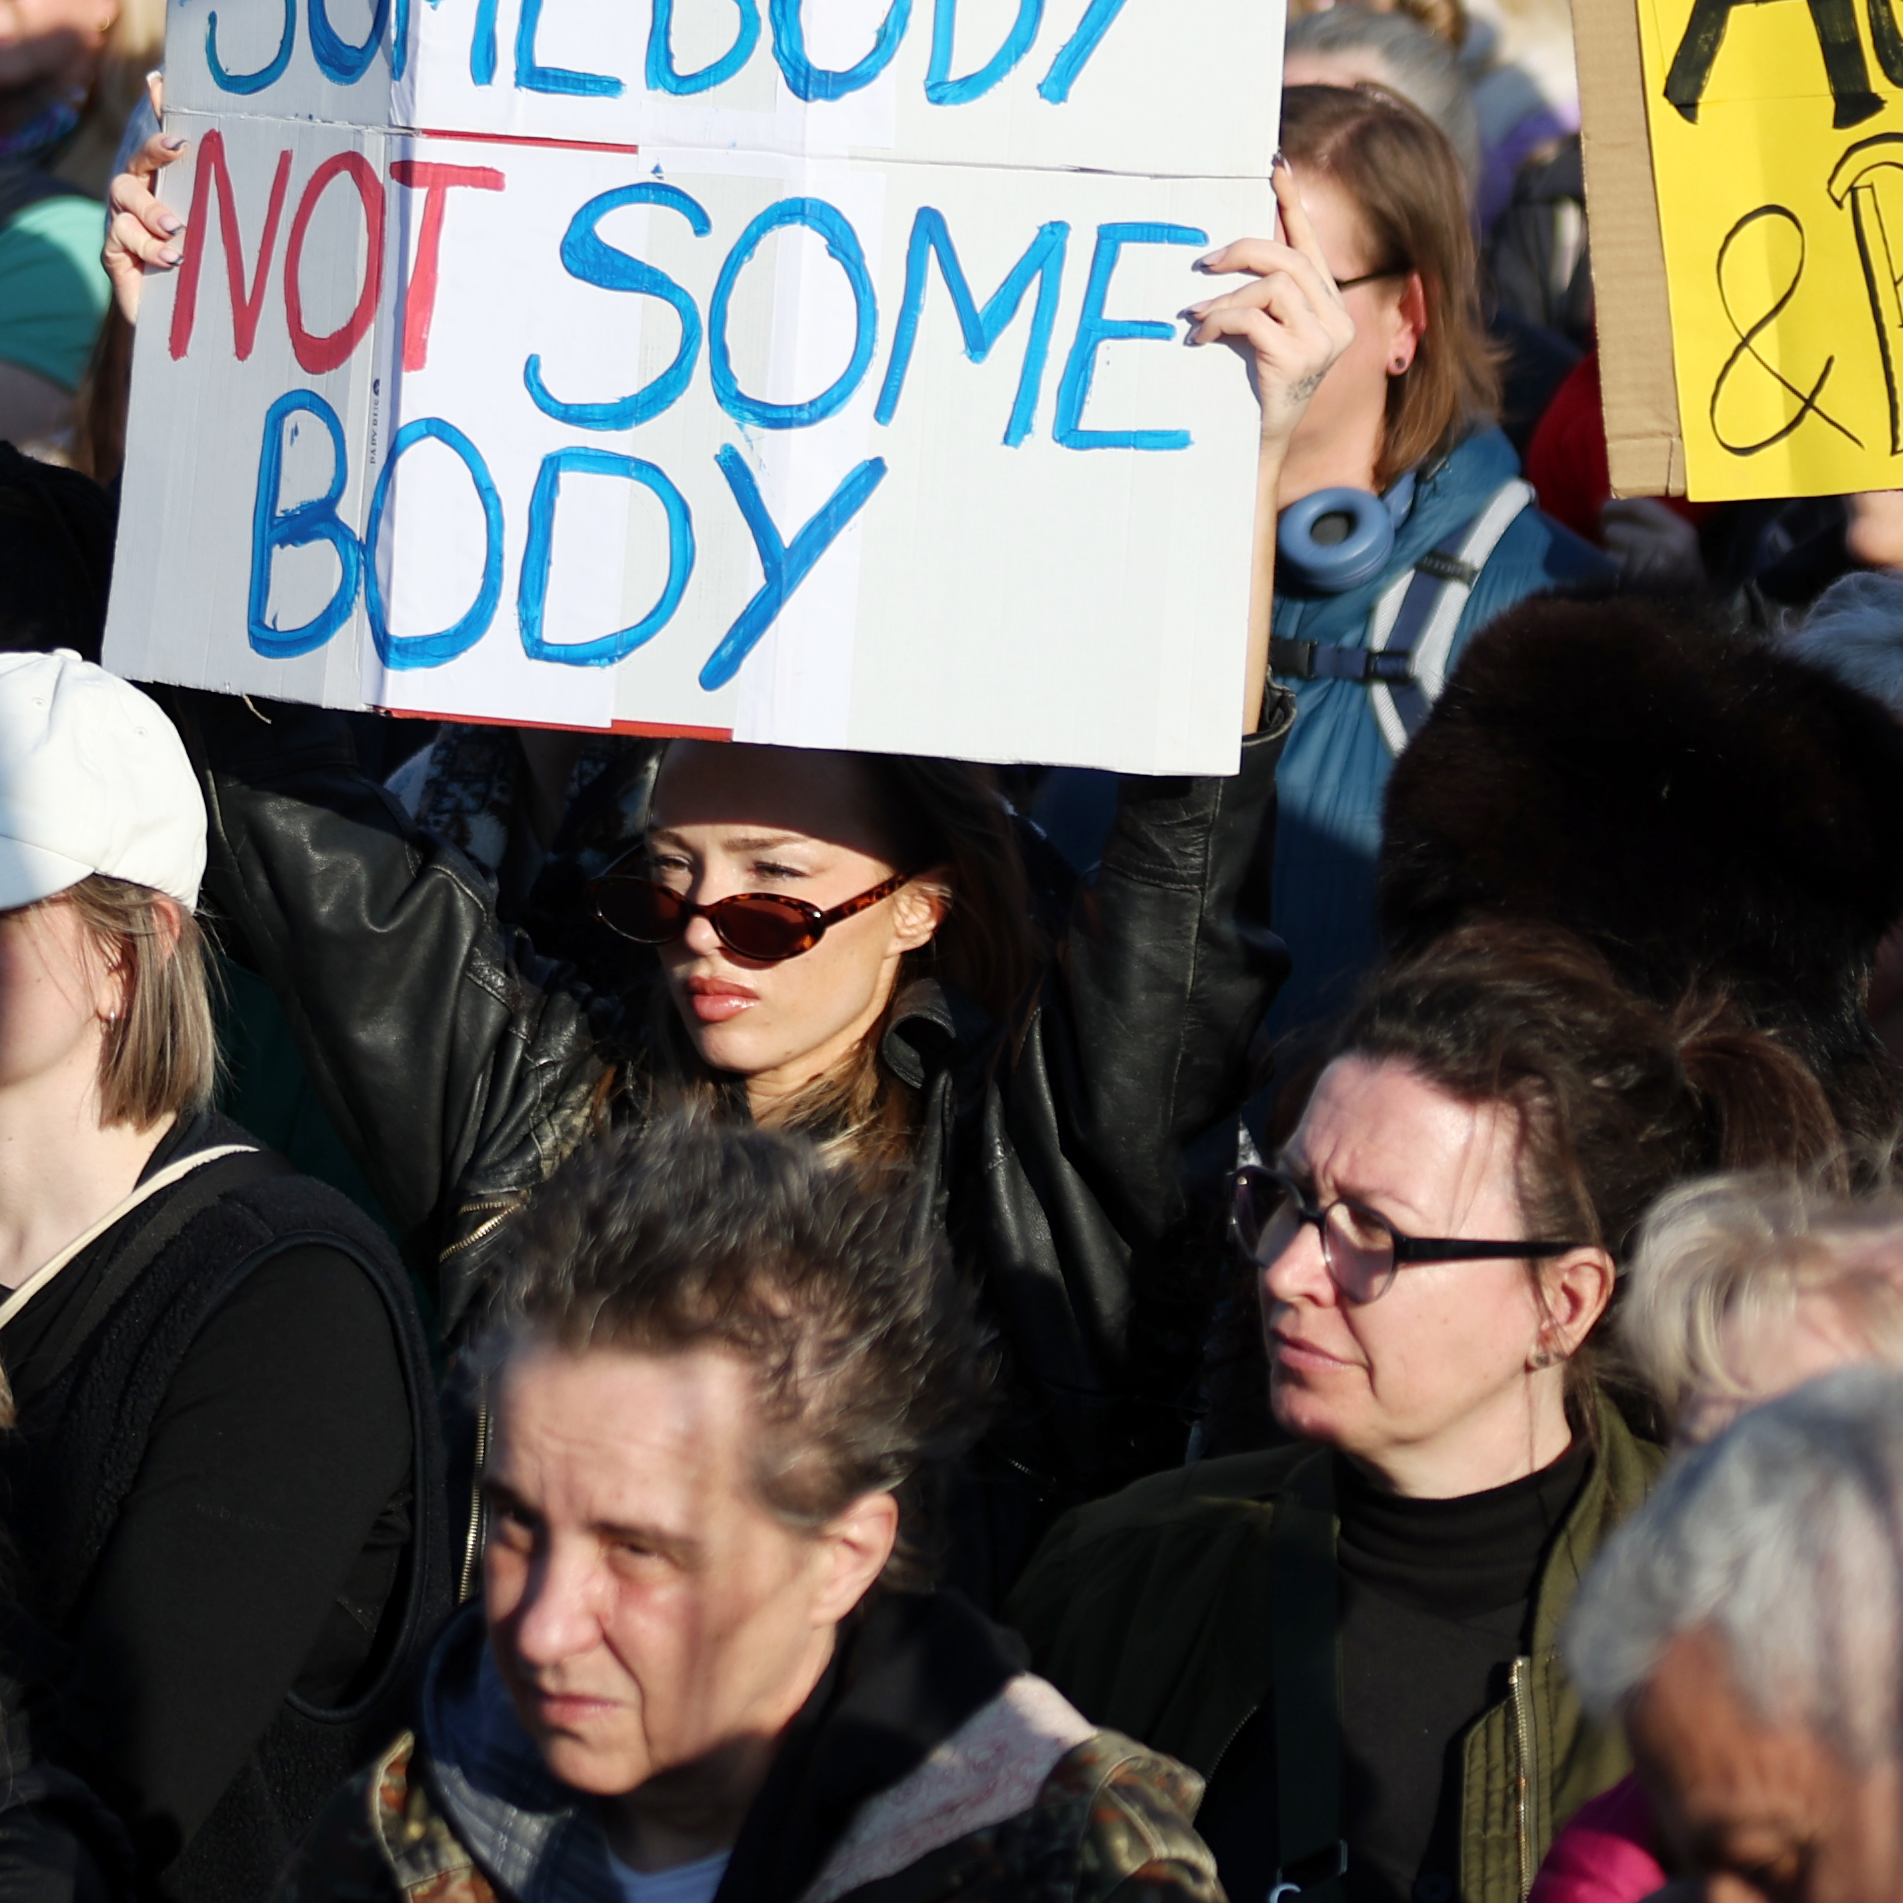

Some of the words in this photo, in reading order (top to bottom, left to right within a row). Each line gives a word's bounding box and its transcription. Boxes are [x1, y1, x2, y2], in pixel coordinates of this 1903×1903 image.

[168, 128, 506, 374] NOT
[524, 180, 1210, 451] SOME
[1709, 205, 1865, 456] &
[247, 388, 888, 691] BODY
